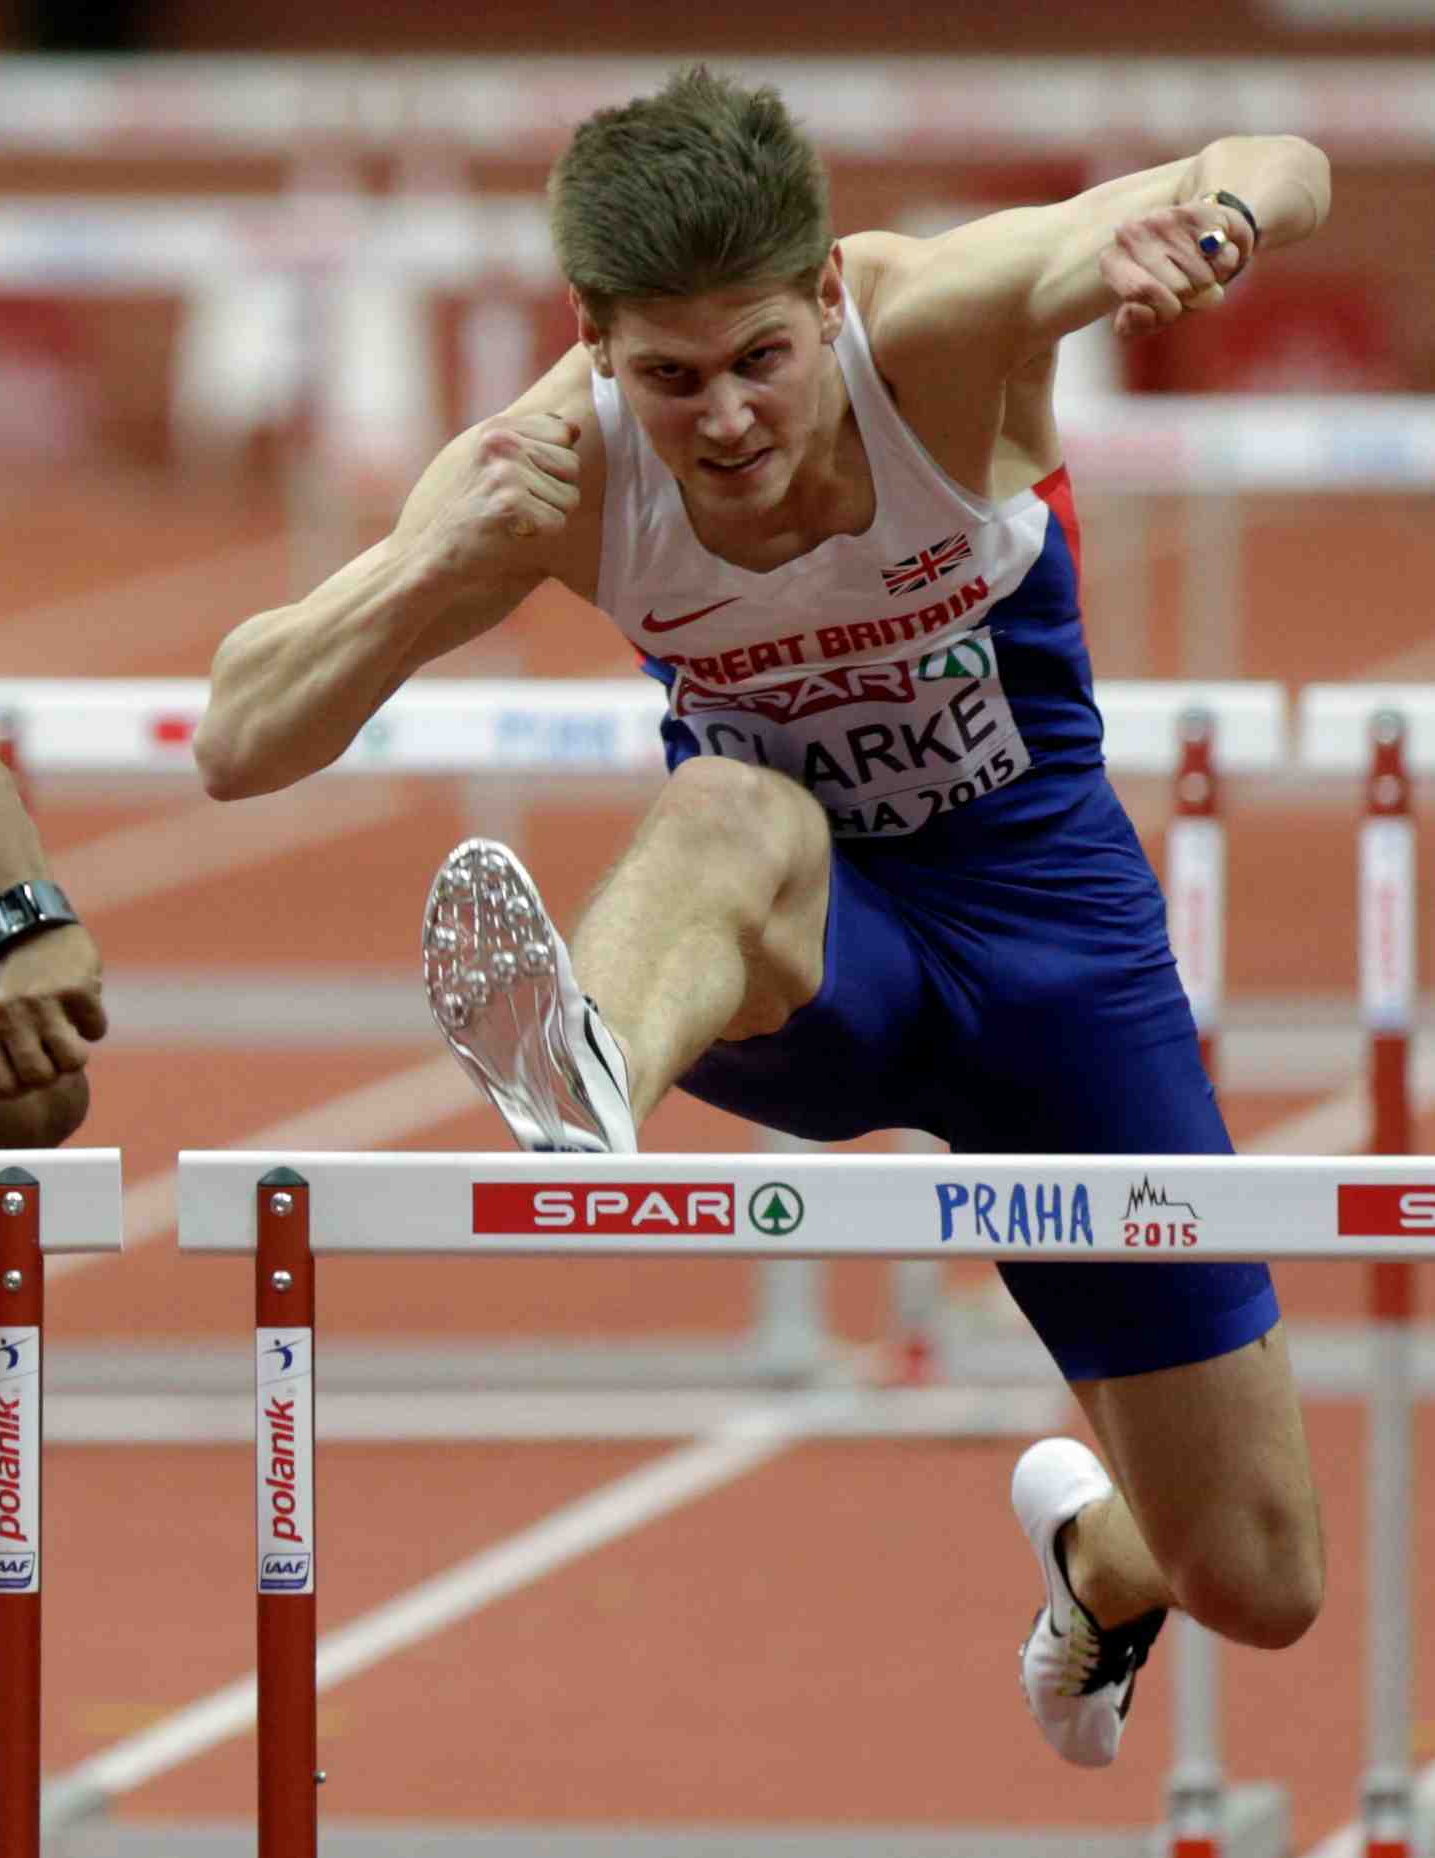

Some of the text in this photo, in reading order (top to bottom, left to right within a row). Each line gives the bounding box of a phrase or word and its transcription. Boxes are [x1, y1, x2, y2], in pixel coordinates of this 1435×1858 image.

[816, 577, 991, 660] BRITAIN
[919, 751, 1016, 817] 2015
[532, 1191, 732, 1227] SPAR
[934, 1183, 1095, 1247] PRAHA
[1122, 1221, 1199, 1248] 2015
[265, 1397, 303, 1542] polanik
[265, 1560, 306, 1575] IAAF
